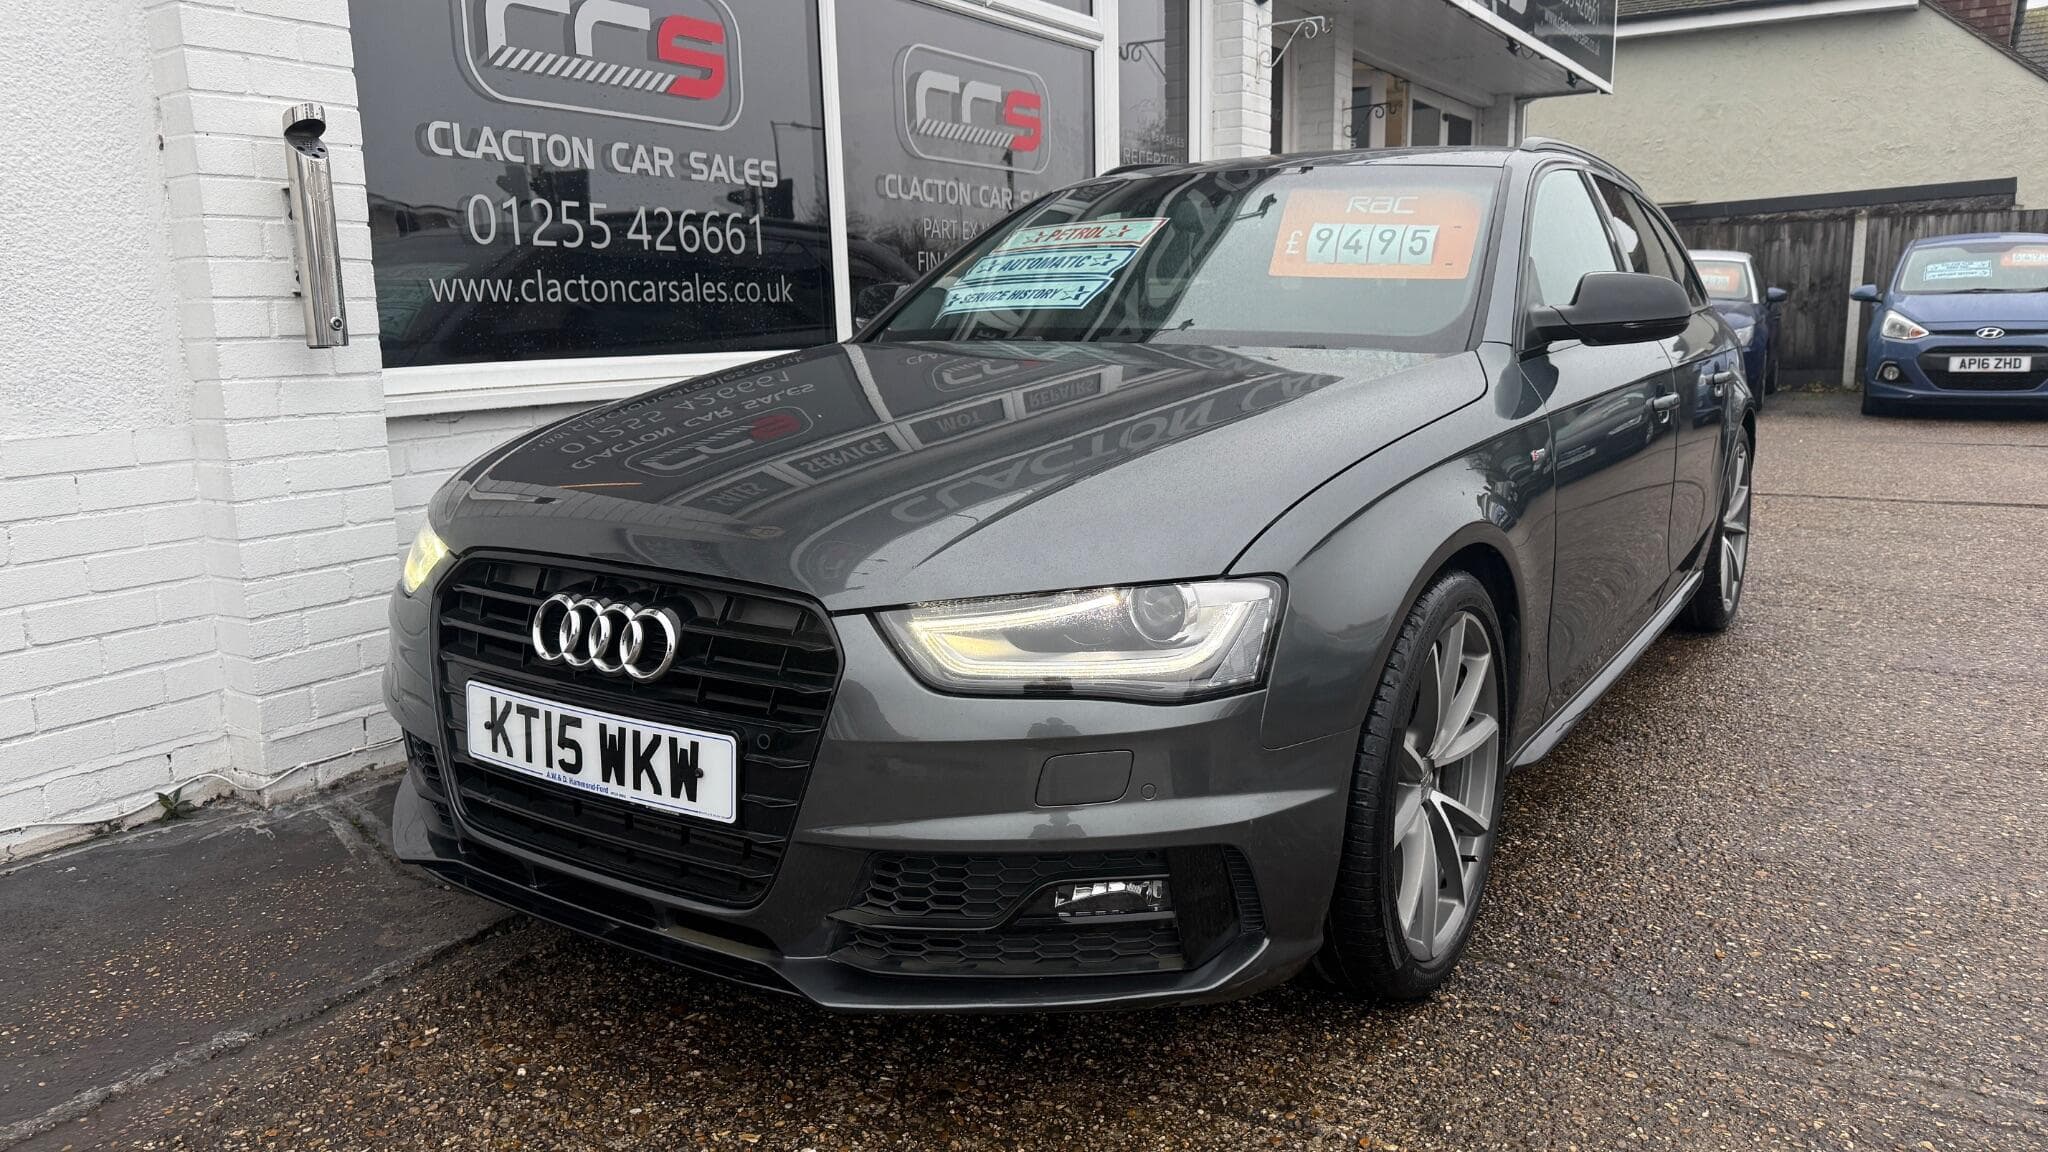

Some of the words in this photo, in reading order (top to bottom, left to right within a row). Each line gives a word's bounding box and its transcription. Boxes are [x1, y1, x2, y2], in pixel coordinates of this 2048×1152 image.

[427, 120, 595, 170] CLACTON
[611, 141, 676, 178] CAR
[688, 151, 779, 188] SALES
[885, 173, 971, 206] CLACTON
[979, 185, 1013, 211] CAR
[1345, 195, 1419, 215] RAC
[467, 193, 612, 250] 01255
[626, 205, 763, 256] 426661
[922, 217, 958, 240] PART
[962, 220, 979, 241] EX
[1043, 226, 1108, 243] PETROL
[996, 255, 1093, 273] AUTOMATIC
[428, 269, 794, 303] www.clactoncarsales.co.uk
[959, 289, 1007, 304] SERVICE
[1008, 288, 1063, 301] HISTORY
[1959, 358, 1990, 370] AP16
[1994, 358, 2022, 370] ZHD
[489, 696, 584, 775] KT15
[598, 722, 700, 802] WKW
